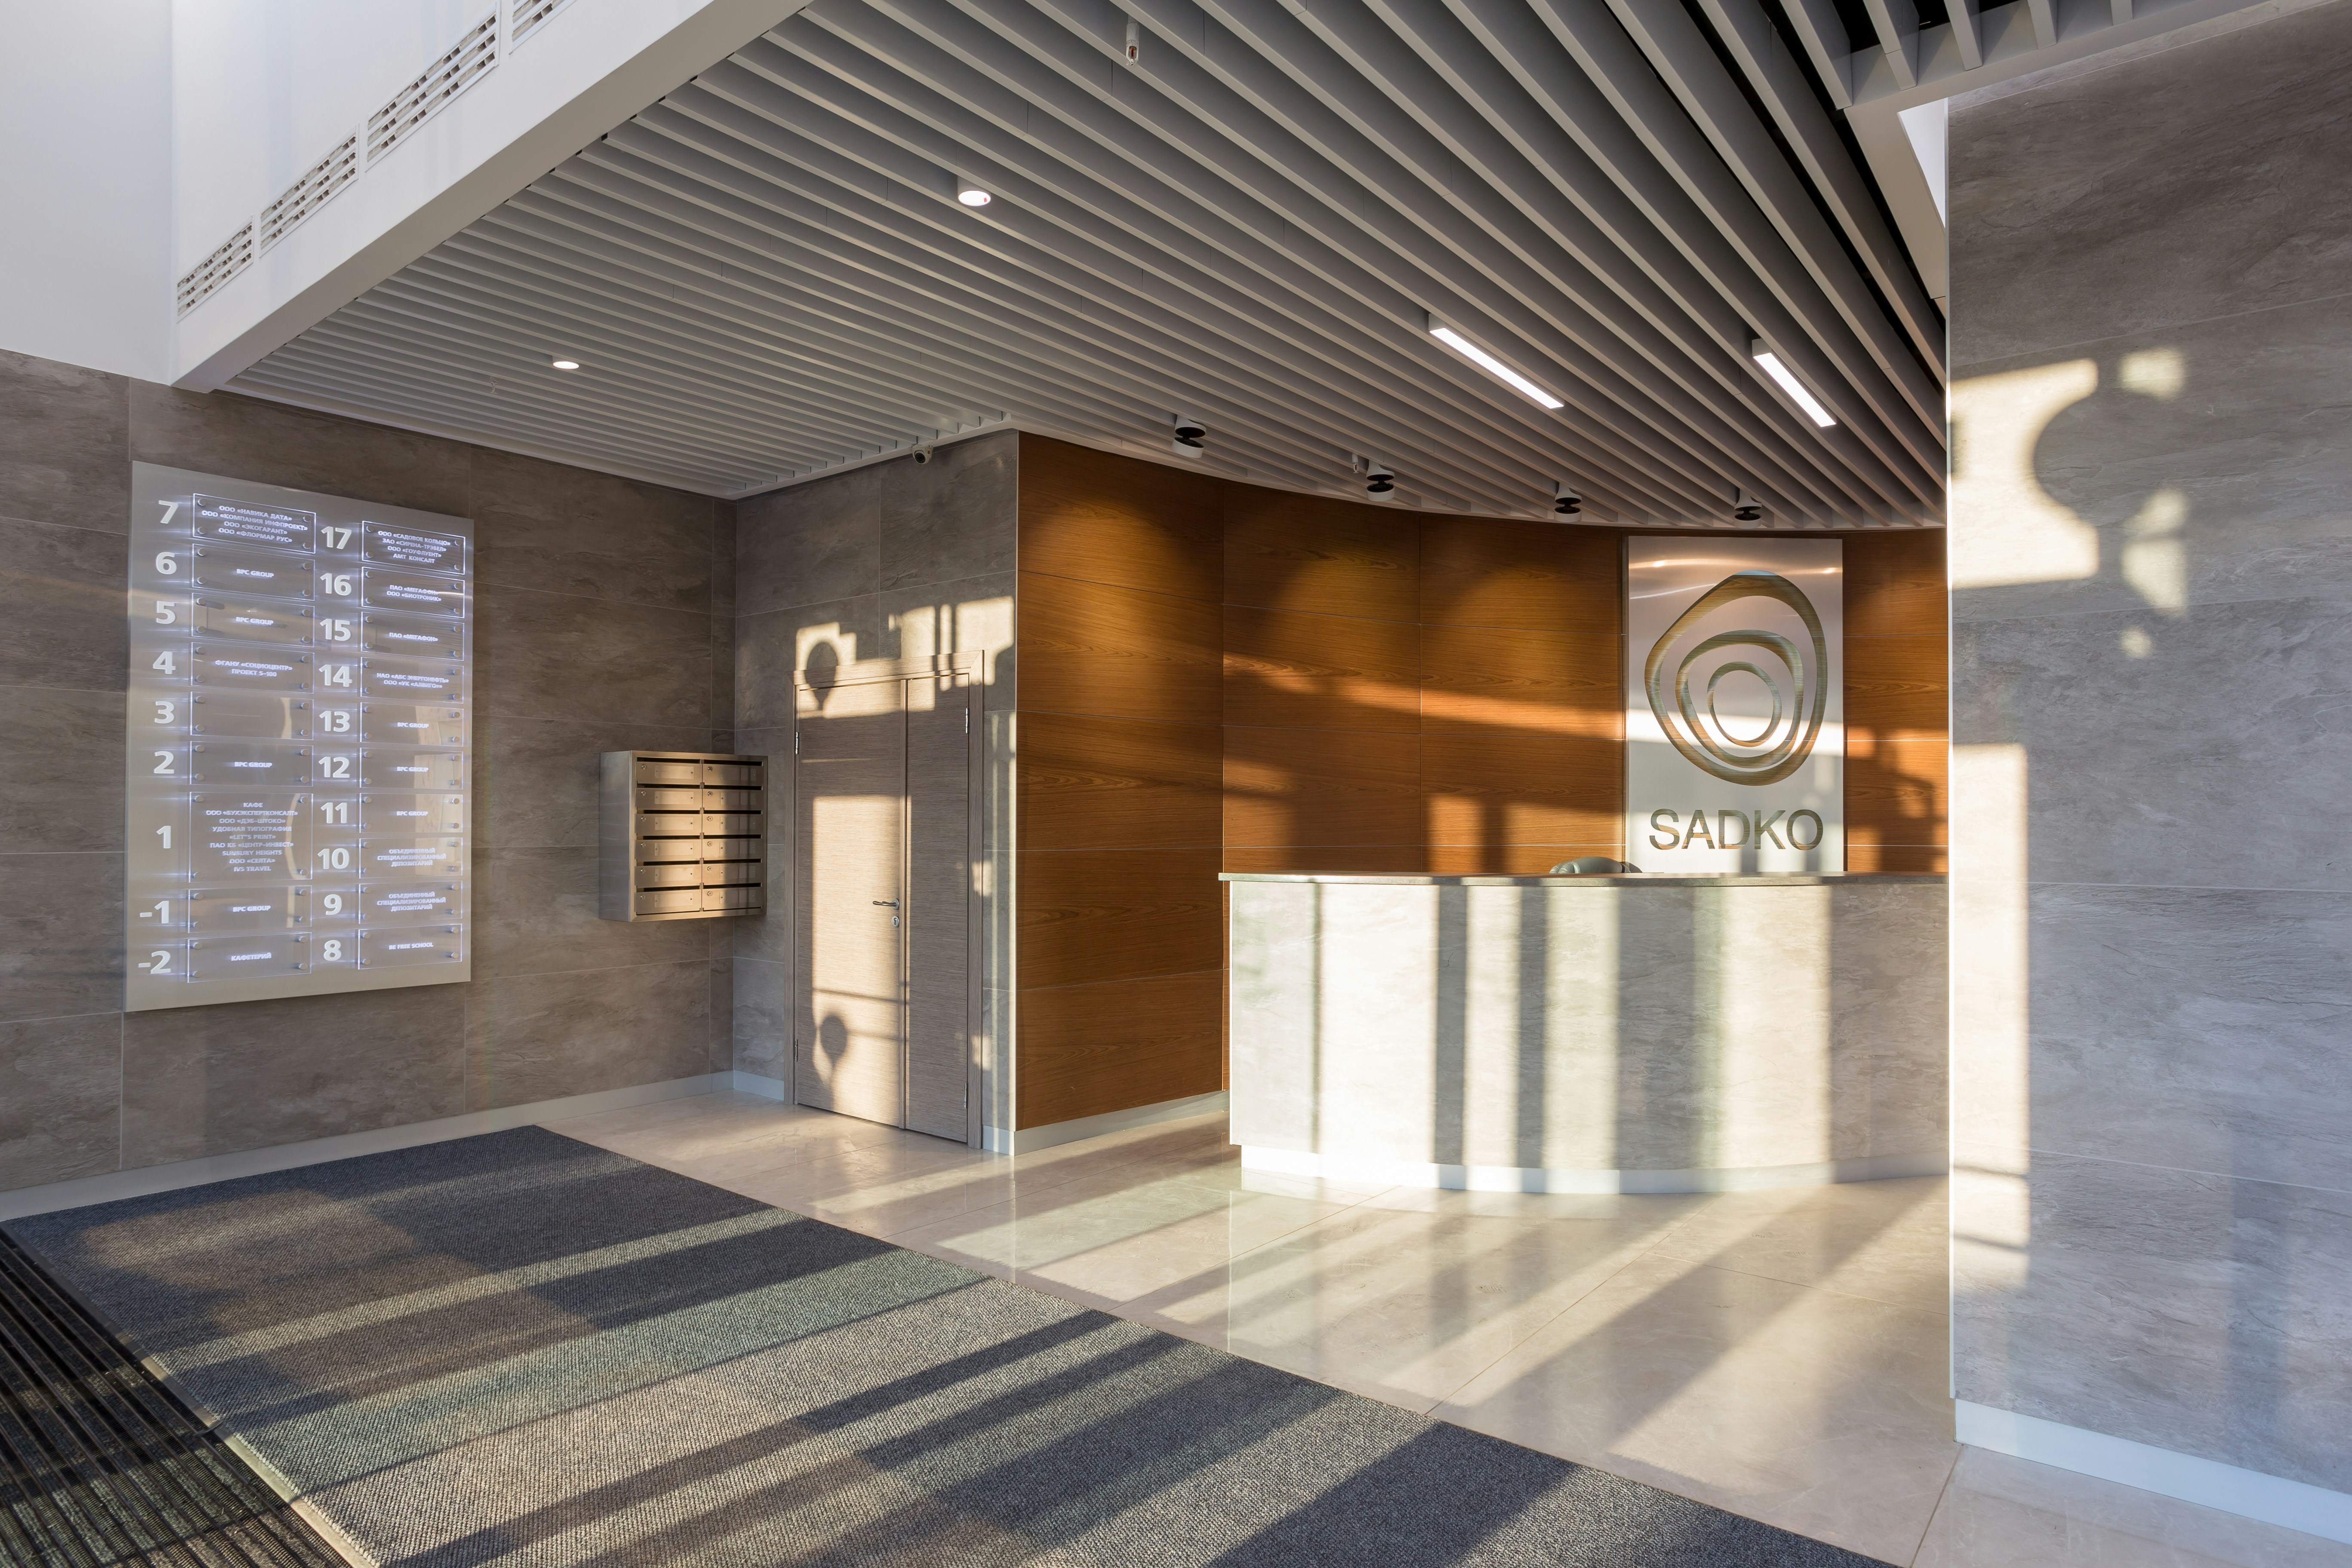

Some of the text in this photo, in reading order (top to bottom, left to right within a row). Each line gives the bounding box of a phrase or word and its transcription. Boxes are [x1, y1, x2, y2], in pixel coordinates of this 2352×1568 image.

[159, 500, 178, 524] 7
[321, 526, 352, 549] 17
[156, 551, 177, 574] 6
[320, 573, 352, 596] 16
[156, 601, 176, 624] 5
[320, 619, 351, 641] 15
[153, 651, 176, 674] 4
[318, 664, 352, 687] 14
[154, 701, 175, 724] 3
[318, 710, 350, 732] 13
[154, 751, 175, 774] 2
[318, 756, 350, 778] 12
[321, 802, 347, 824] 11
[156, 825, 171, 849] 1
[1649, 808, 1824, 850] SADKO
[318, 848, 349, 870] 10
[140, 900, 169, 924] -1
[324, 894, 342, 916] 9
[138, 950, 171, 974] -2
[323, 940, 341, 961] 8
